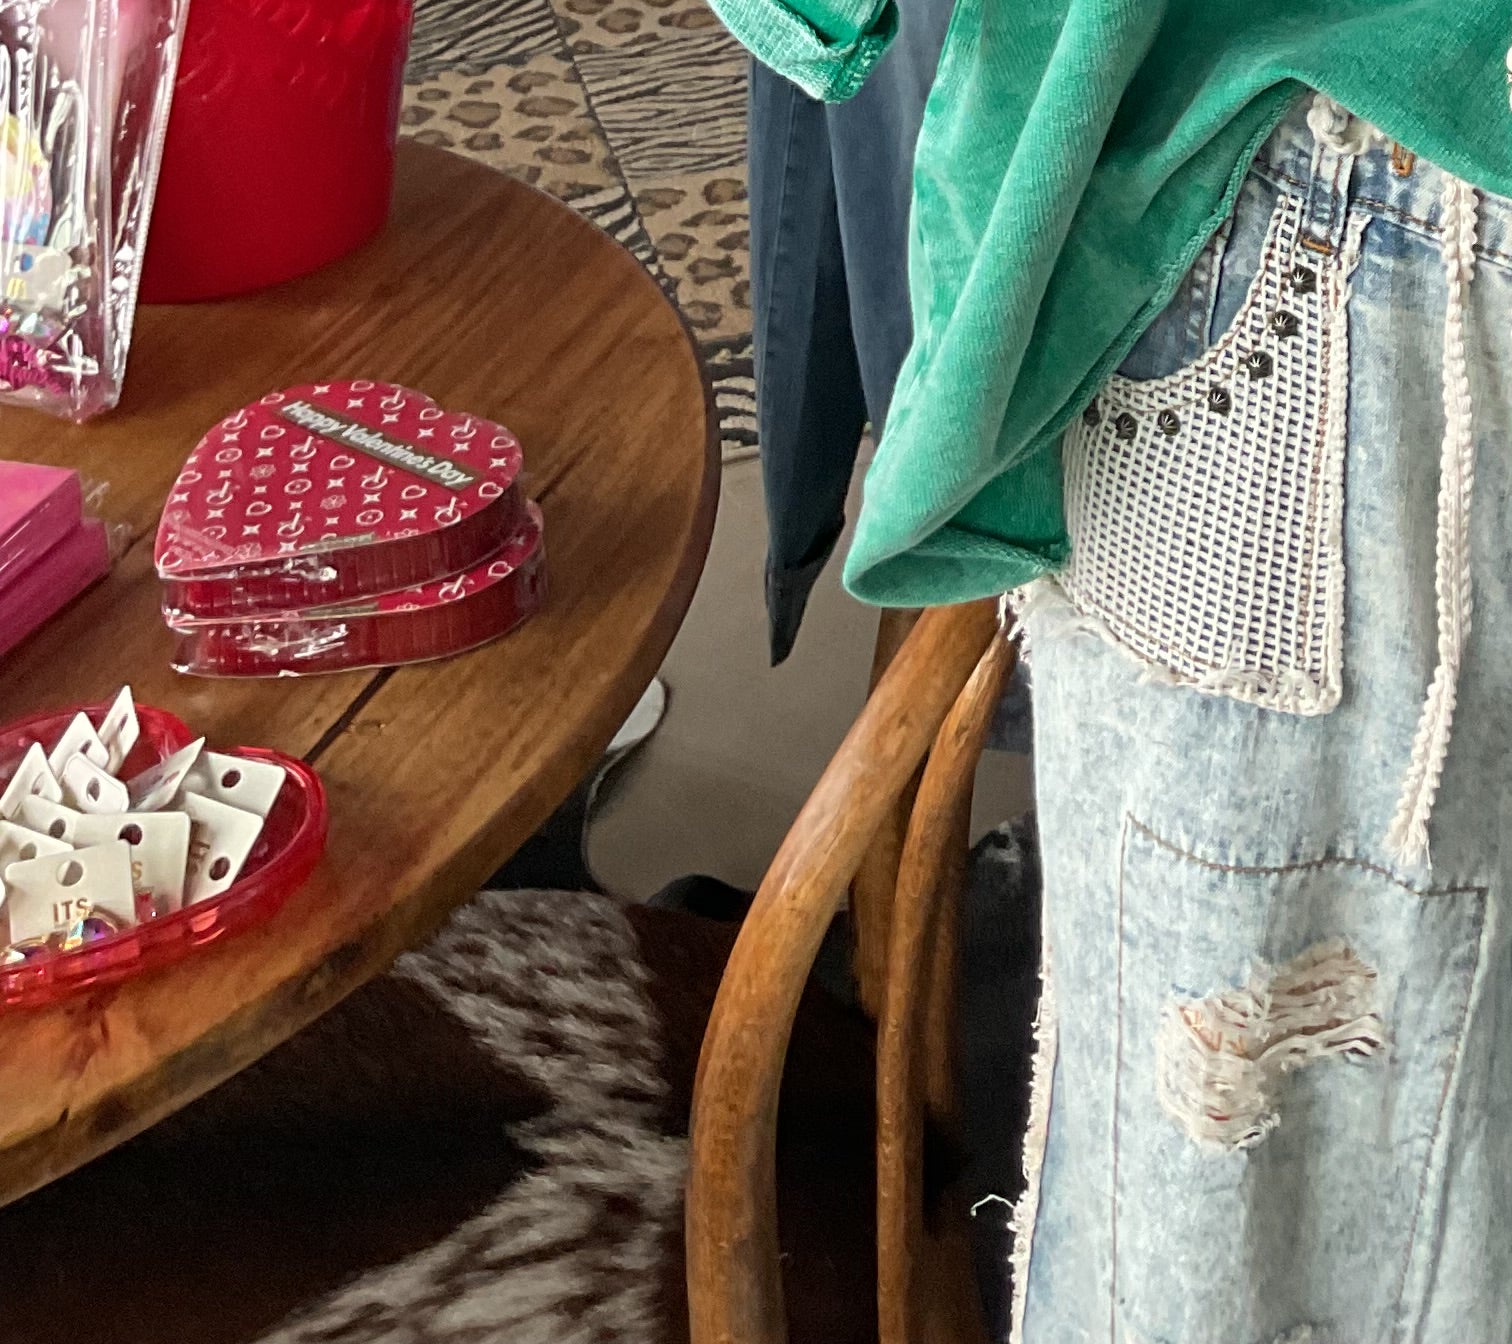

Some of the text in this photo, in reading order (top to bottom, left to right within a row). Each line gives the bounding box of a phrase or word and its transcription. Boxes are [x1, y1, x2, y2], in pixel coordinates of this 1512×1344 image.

[281, 400, 474, 487] Happy Valentine's Day
